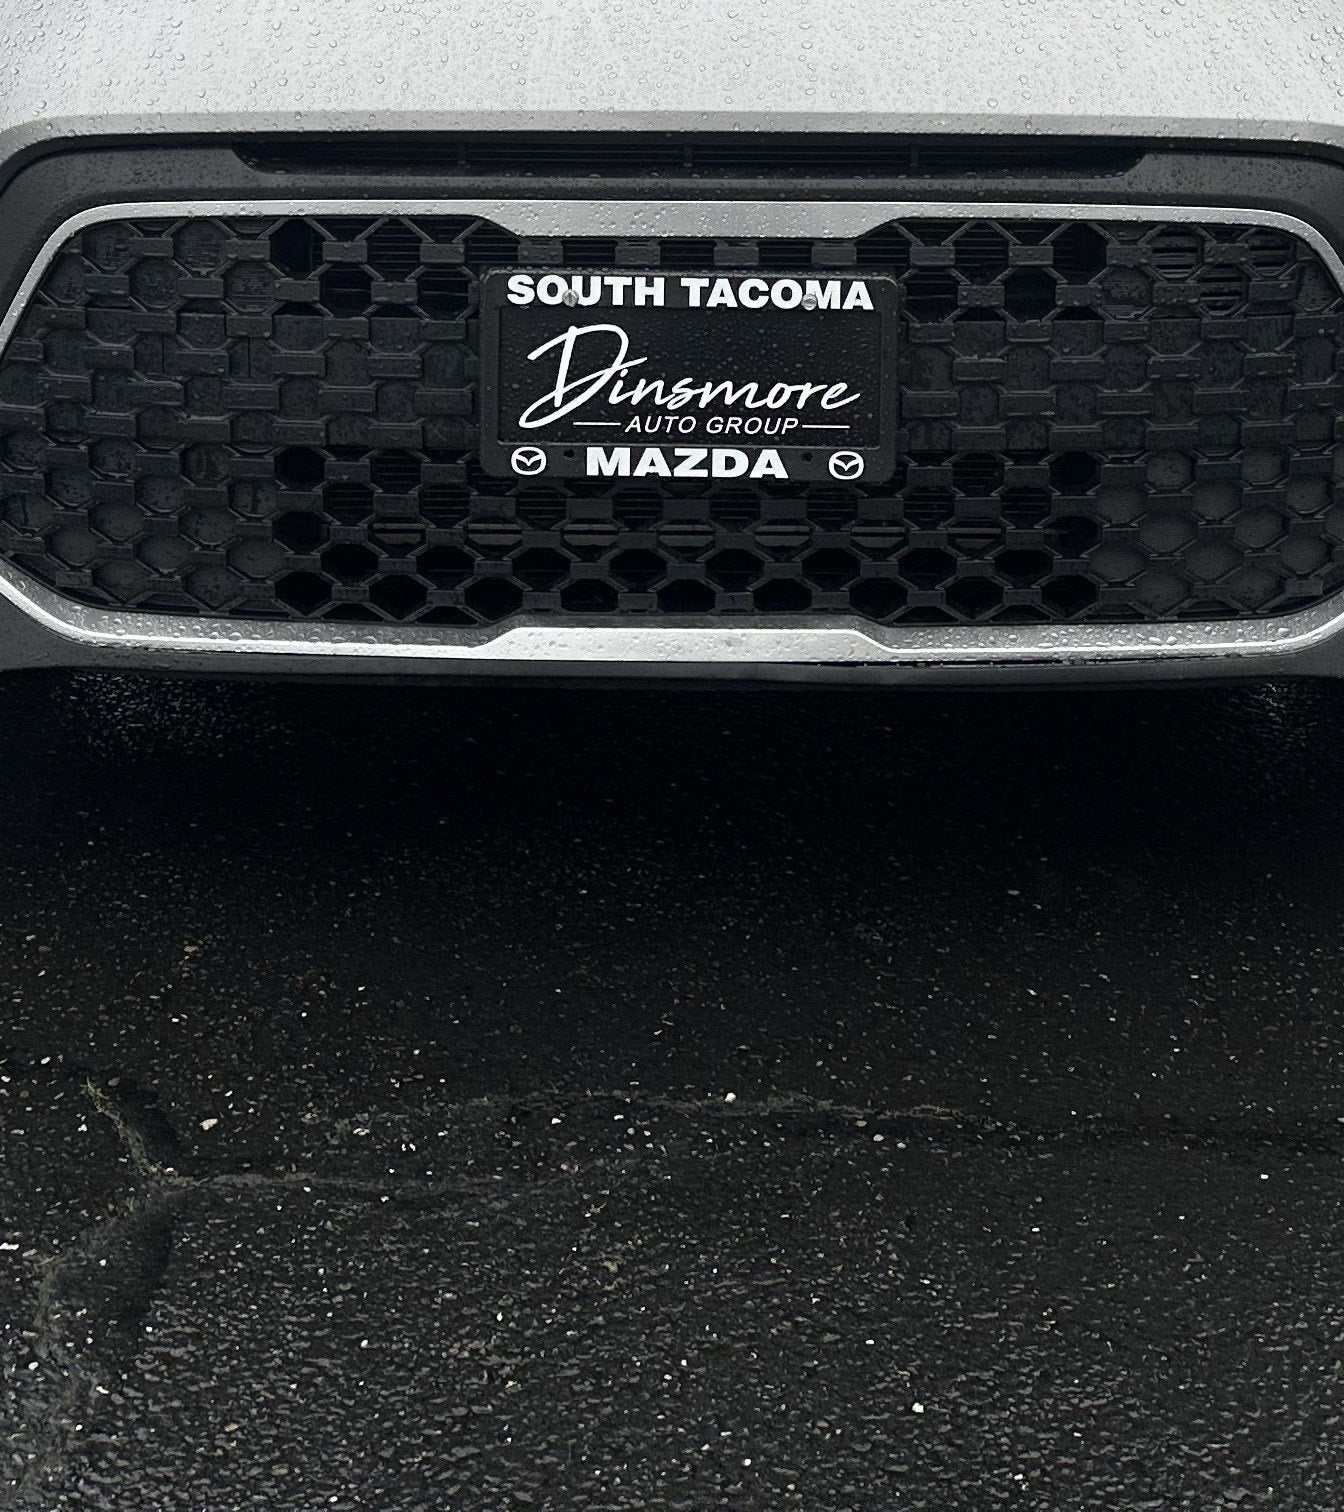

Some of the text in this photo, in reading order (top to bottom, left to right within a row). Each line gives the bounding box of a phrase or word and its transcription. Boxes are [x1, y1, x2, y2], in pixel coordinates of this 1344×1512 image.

[506, 274, 875, 310] SOUTH TACOMA
[518, 323, 861, 429] Dinsmore
[624, 415, 800, 435] AUTO GROUP
[585, 446, 789, 480] MAZDA
